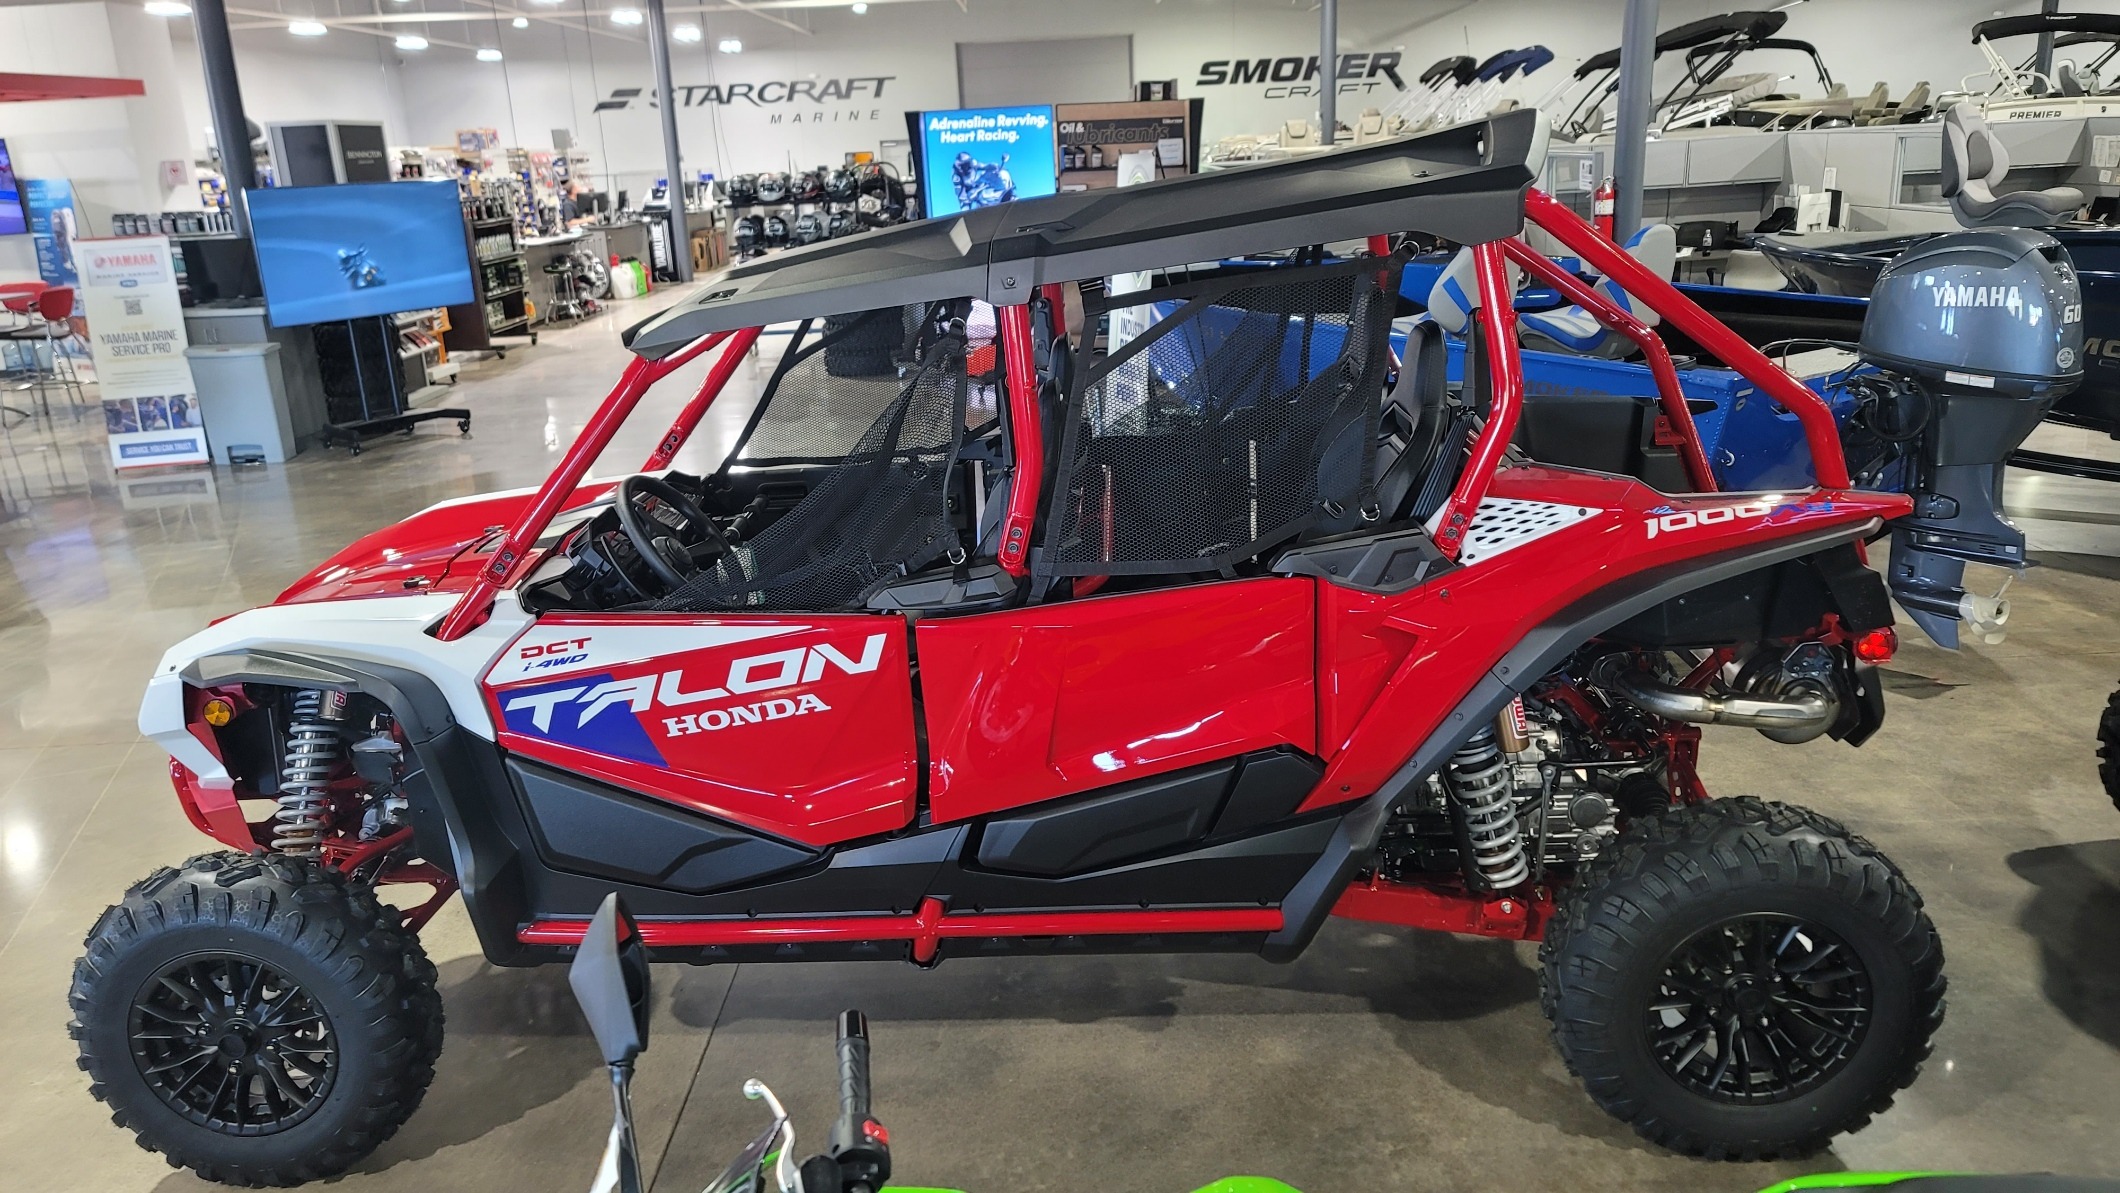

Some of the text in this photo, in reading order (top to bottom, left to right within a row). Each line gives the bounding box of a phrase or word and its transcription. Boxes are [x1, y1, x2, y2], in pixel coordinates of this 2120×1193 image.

[1196, 52, 1409, 92] SMOKER
[770, 109, 880, 125] MARINE
[929, 112, 1049, 131] Adrenaline Revving.
[2009, 110, 2062, 120] PREMIER
[940, 128, 1020, 144] Heart Racing.
[1059, 121, 1085, 134] Oil &
[1067, 122, 1170, 145] lubricants
[107, 253, 158, 268] YAMAHA
[1932, 286, 2022, 308] YAMAHA
[2063, 304, 2082, 324] 60
[100, 329, 178, 345] YAMAHA MARINE
[112, 342, 171, 357] SERVICE PRO
[521, 636, 592, 660] DCT
[522, 653, 589, 672] i-4WD
[505, 633, 888, 735] TALON
[661, 693, 832, 738] HONDA
